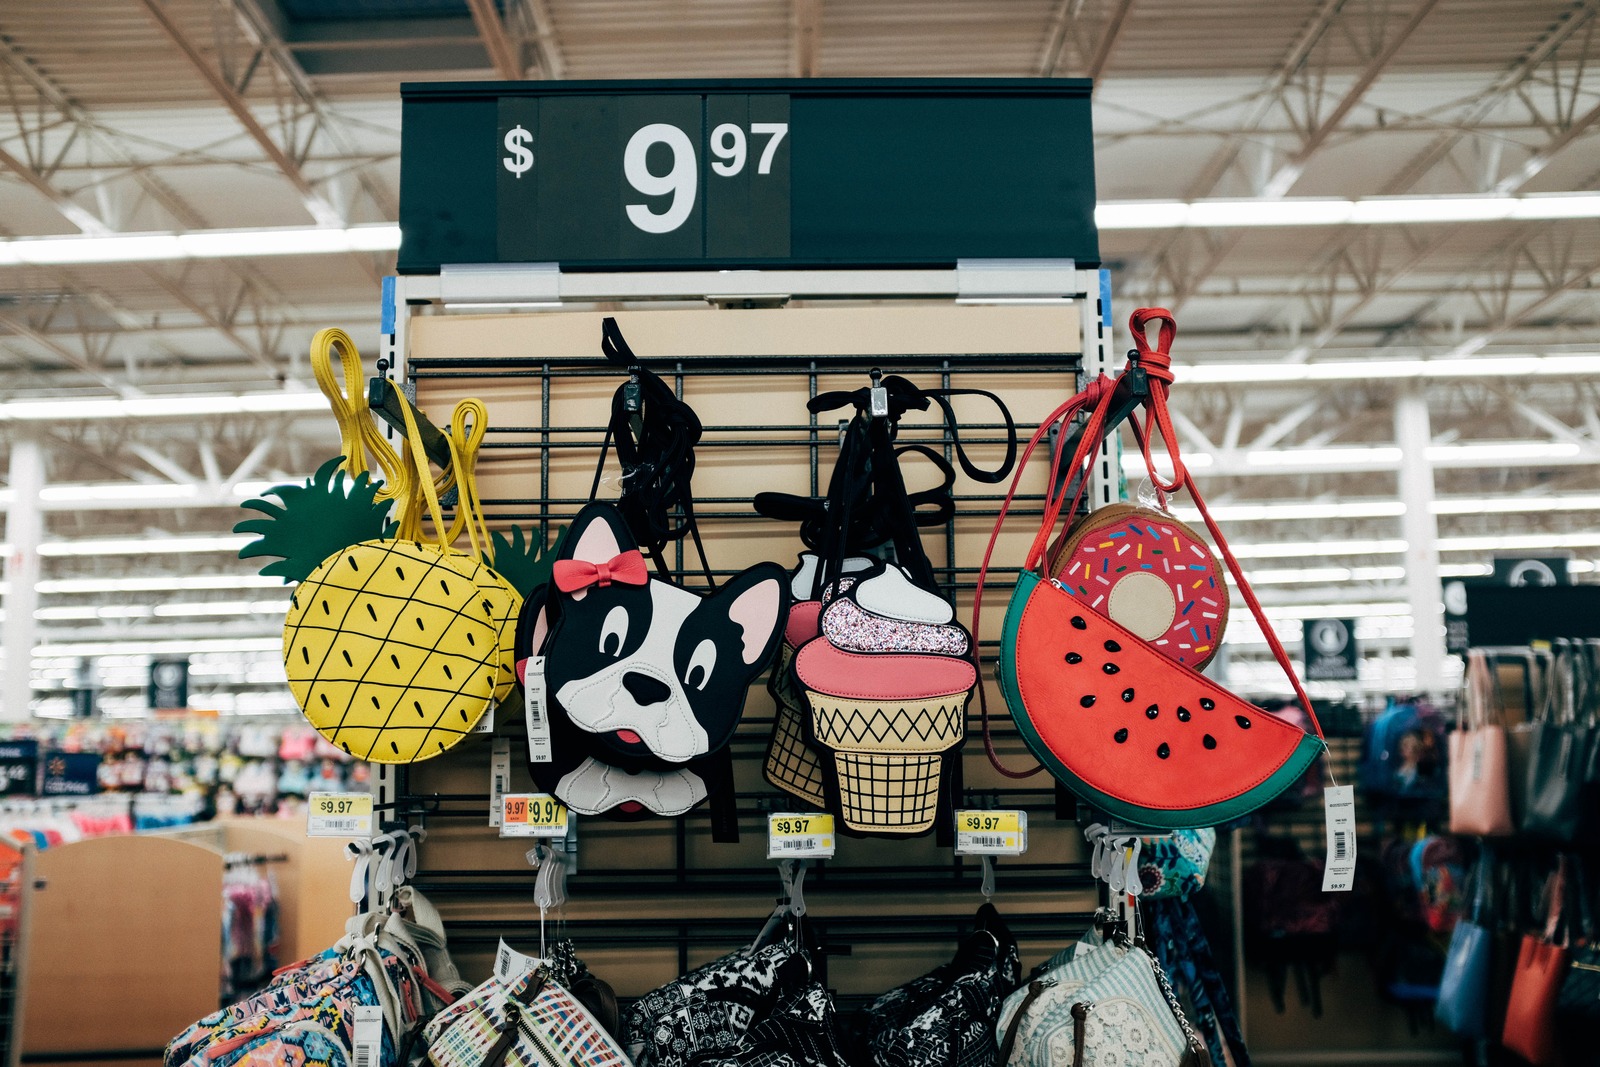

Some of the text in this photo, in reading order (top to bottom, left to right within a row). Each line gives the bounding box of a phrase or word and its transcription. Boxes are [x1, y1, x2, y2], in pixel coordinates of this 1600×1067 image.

[503, 123, 789, 234] $ 9 97
[320, 801, 353, 813] $9.97
[527, 801, 561, 823] $9.97
[777, 819, 810, 834] $9.97
[967, 817, 1000, 830] $9.97
